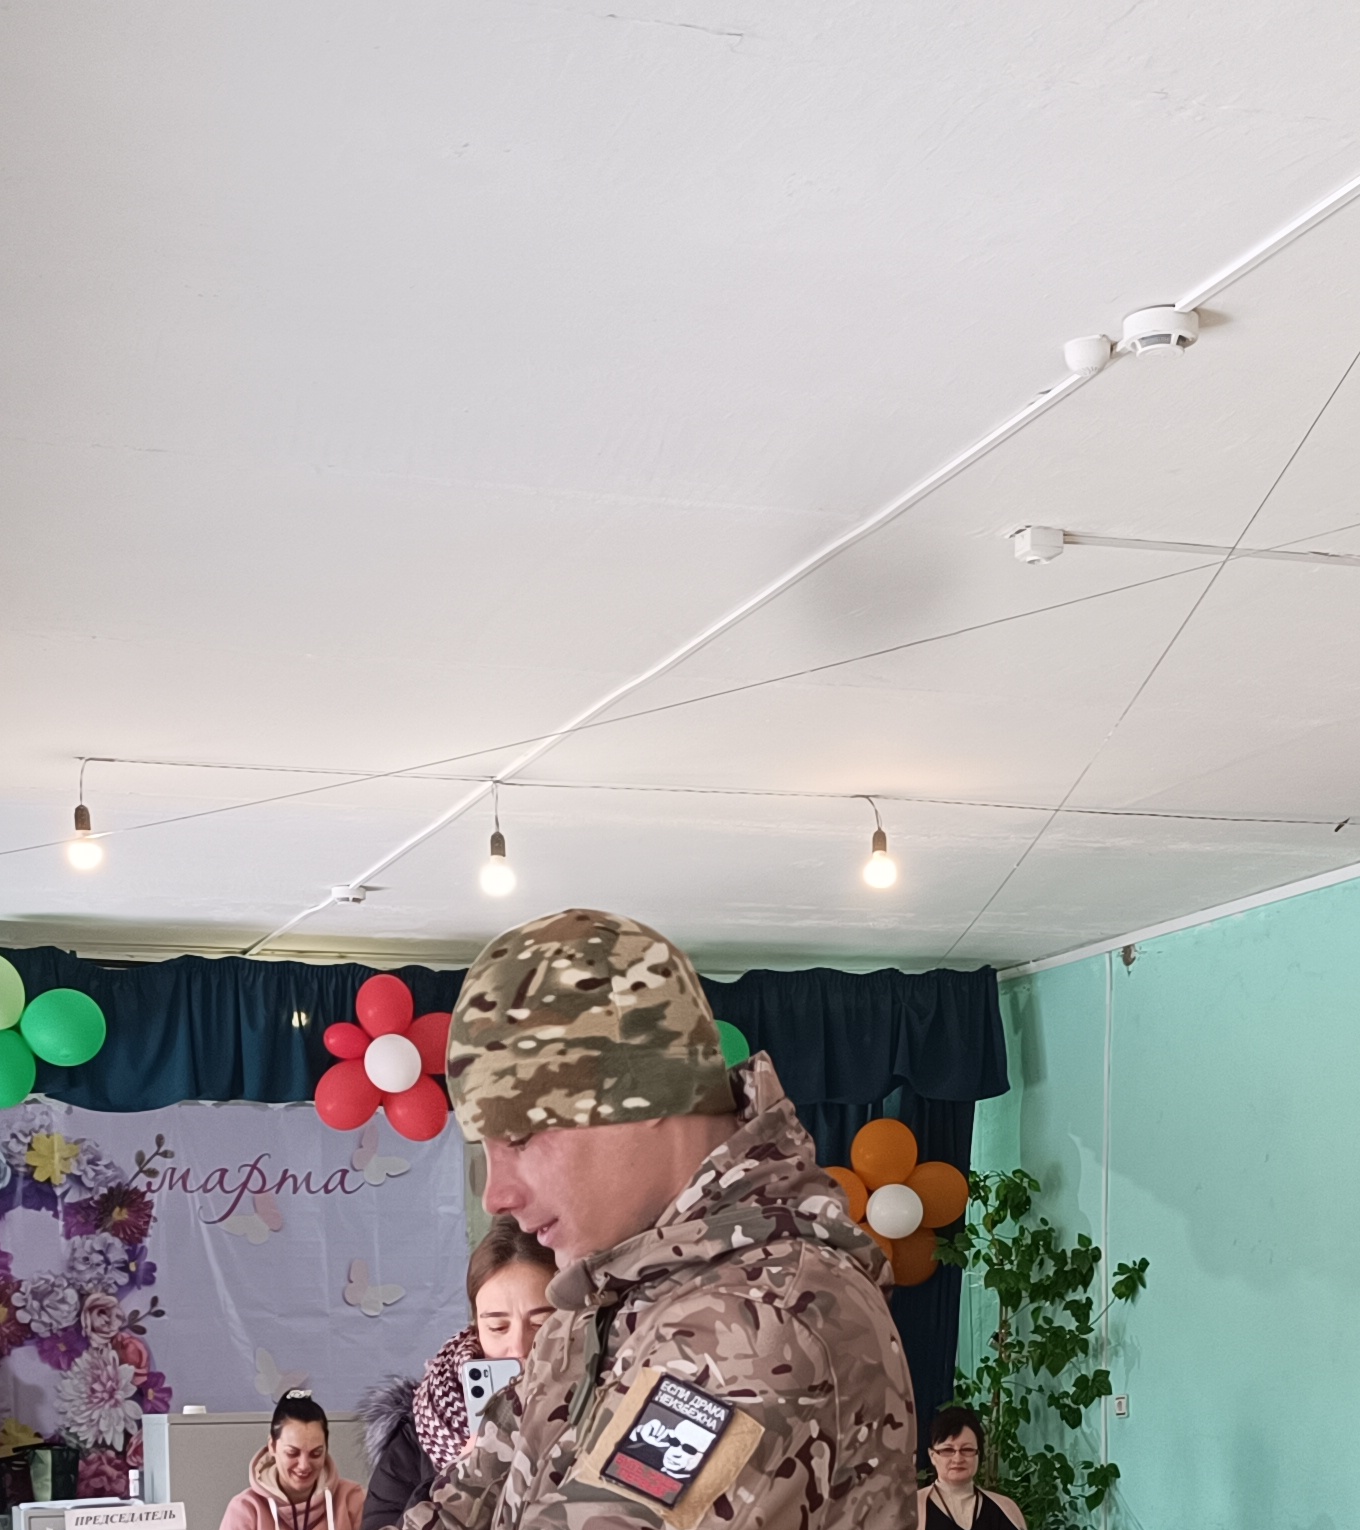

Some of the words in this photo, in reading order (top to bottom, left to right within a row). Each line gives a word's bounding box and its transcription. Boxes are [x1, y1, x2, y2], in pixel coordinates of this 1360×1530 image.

[141, 1152, 366, 1224] марта
[660, 1380, 691, 1402] ЕСЛИ
[689, 1395, 726, 1422] ДРАКА
[74, 1509, 176, 1527] ПРЕДСЕДАТЕЛЬ
